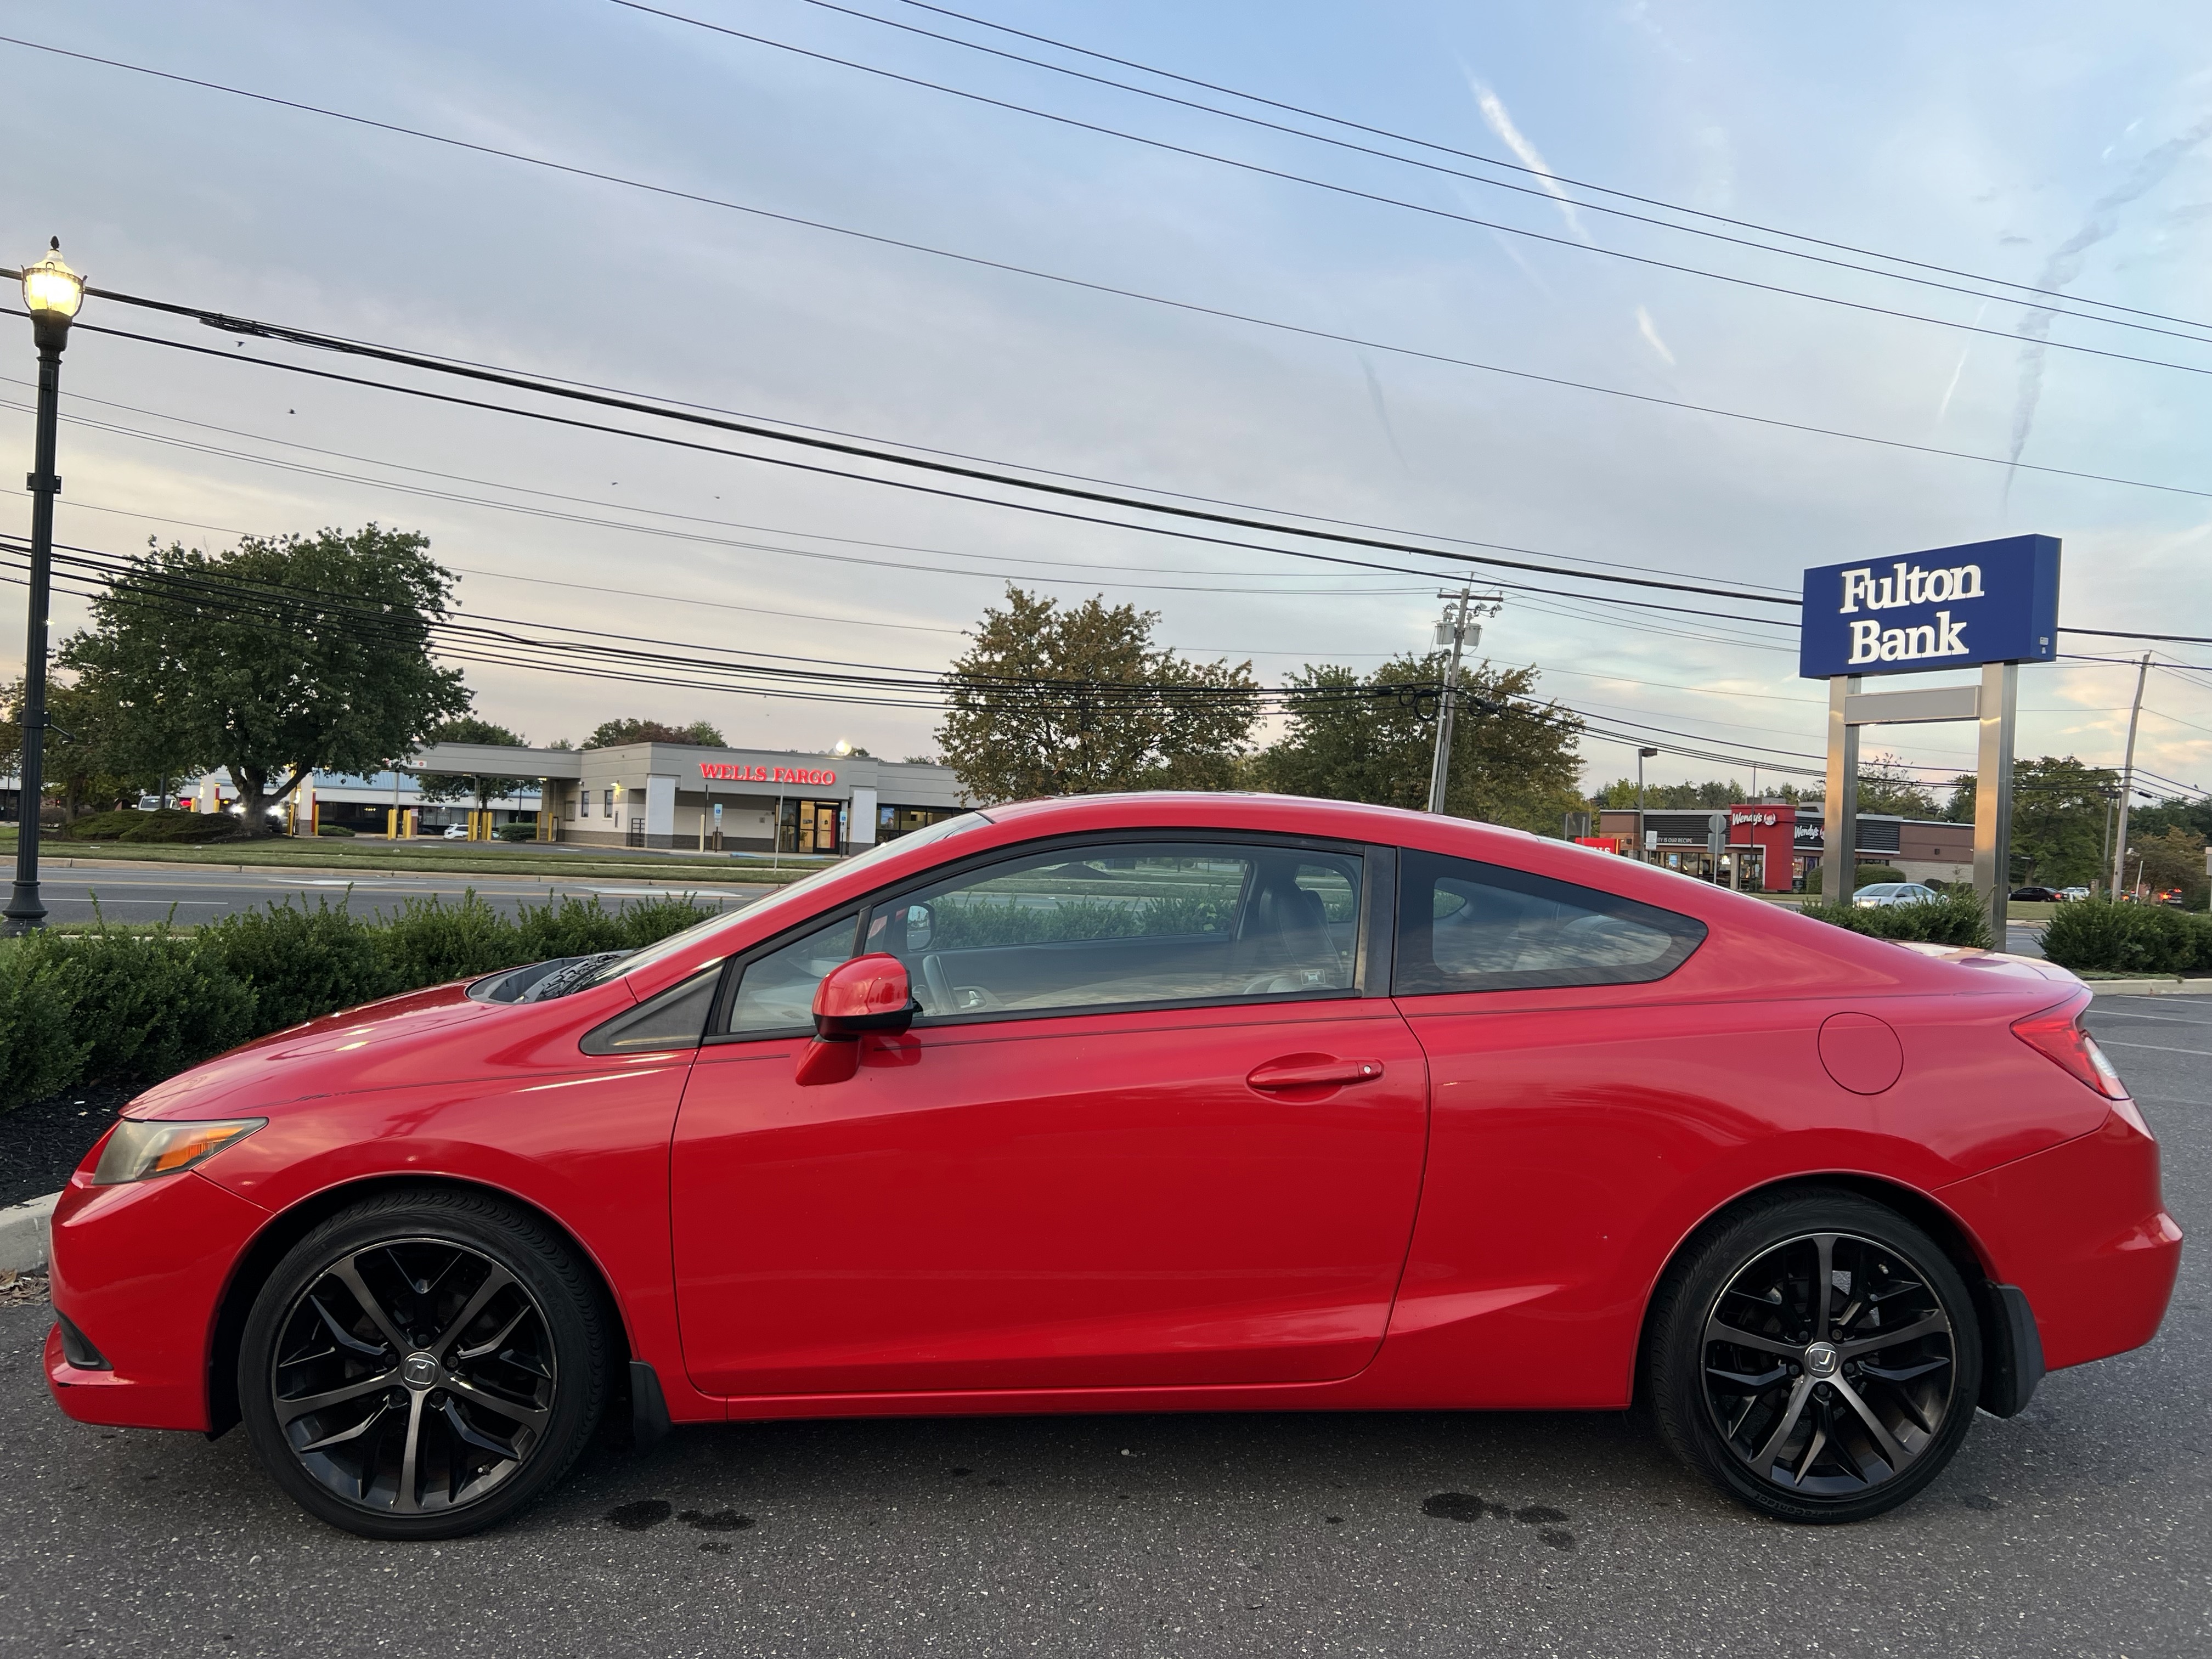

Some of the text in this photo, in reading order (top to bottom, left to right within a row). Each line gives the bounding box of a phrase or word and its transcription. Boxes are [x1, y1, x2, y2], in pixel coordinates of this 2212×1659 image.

[1839, 562, 1984, 613] Fulton
[1848, 611, 1969, 665] Bank
[699, 763, 836, 786] WELLS FARGO
[1795, 825, 1819, 839] Wendy's
